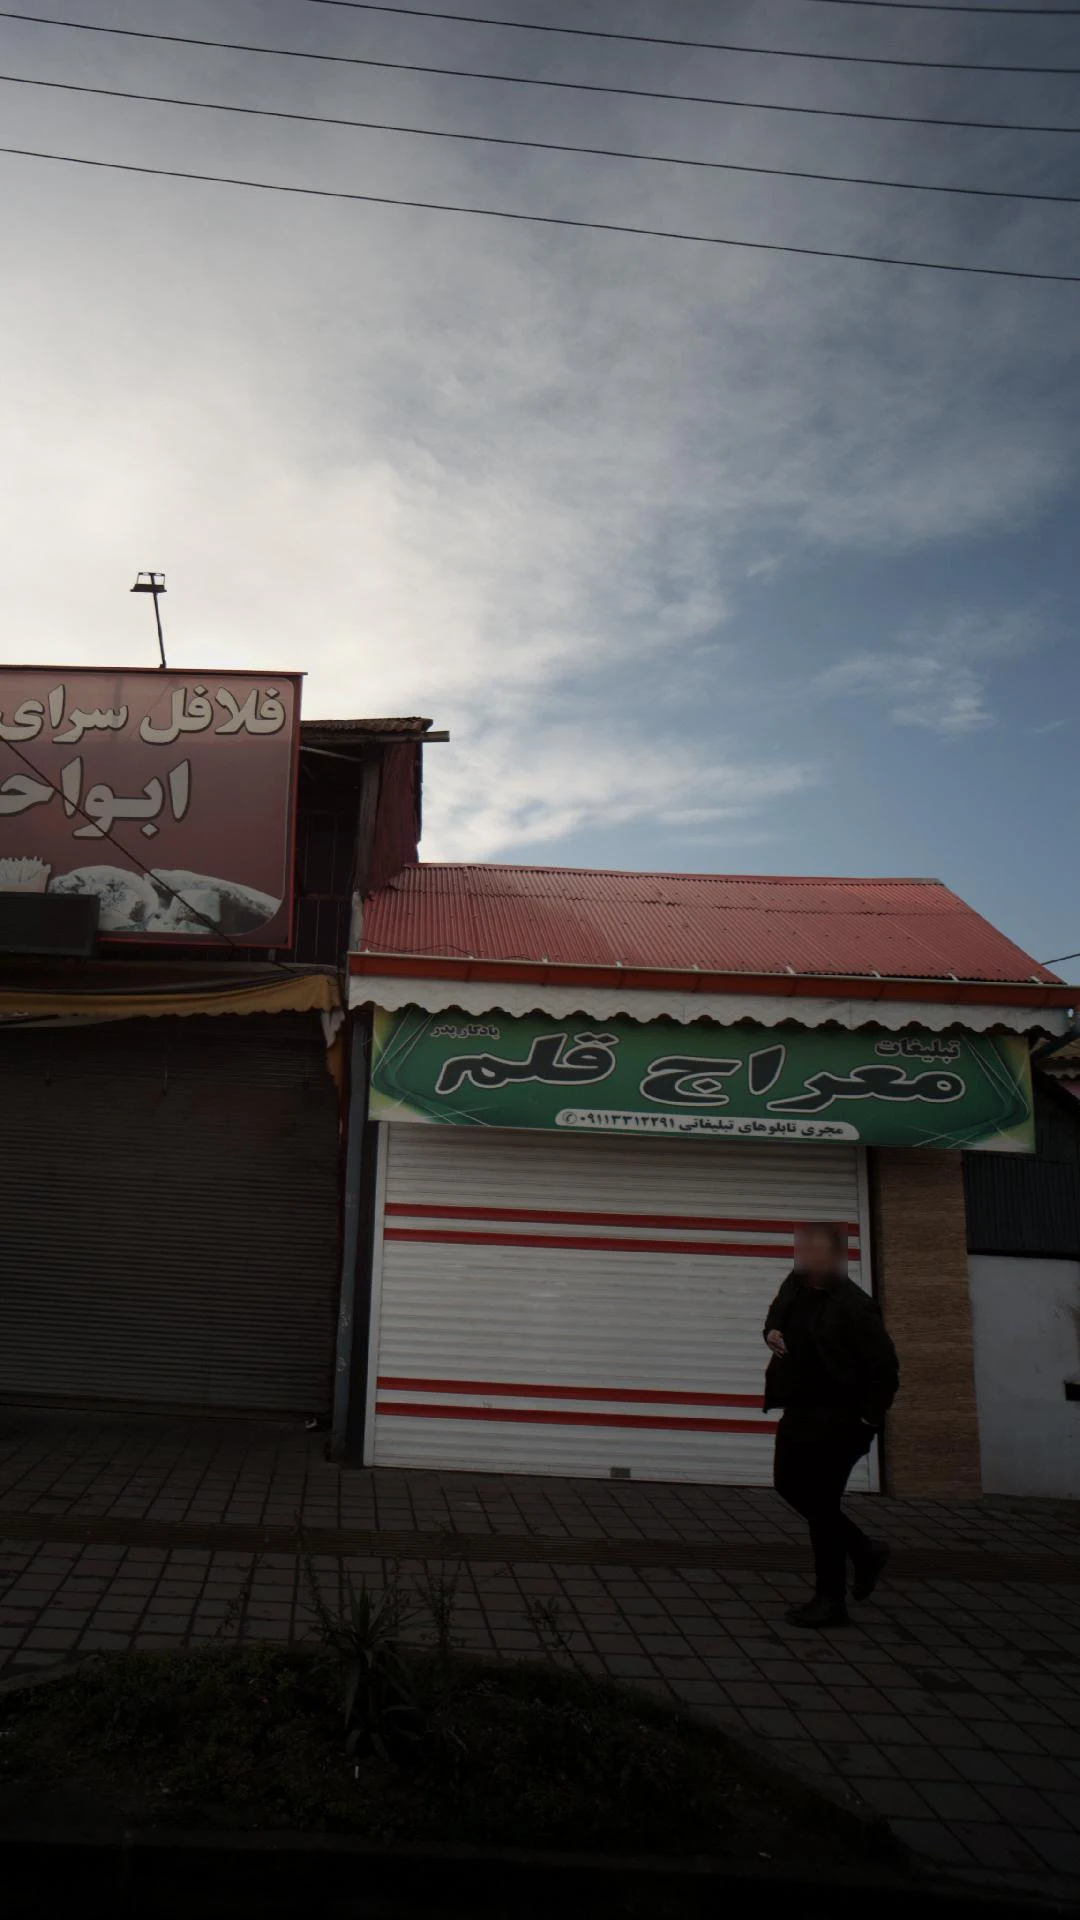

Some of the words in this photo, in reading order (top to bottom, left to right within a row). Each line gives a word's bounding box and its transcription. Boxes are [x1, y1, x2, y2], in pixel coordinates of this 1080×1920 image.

[0, 684, 128, 743] سرای
[140, 685, 286, 744] فلافل
[0, 755, 191, 839] ابواح
[430, 1024, 457, 1038] پدر
[435, 1032, 619, 1095] قلم
[874, 1037, 961, 1064] تبلیغات
[679, 1117, 734, 1133] تبلیغاتی
[738, 1120, 797, 1136] تابلوهای
[801, 1125, 844, 1138] مجری
